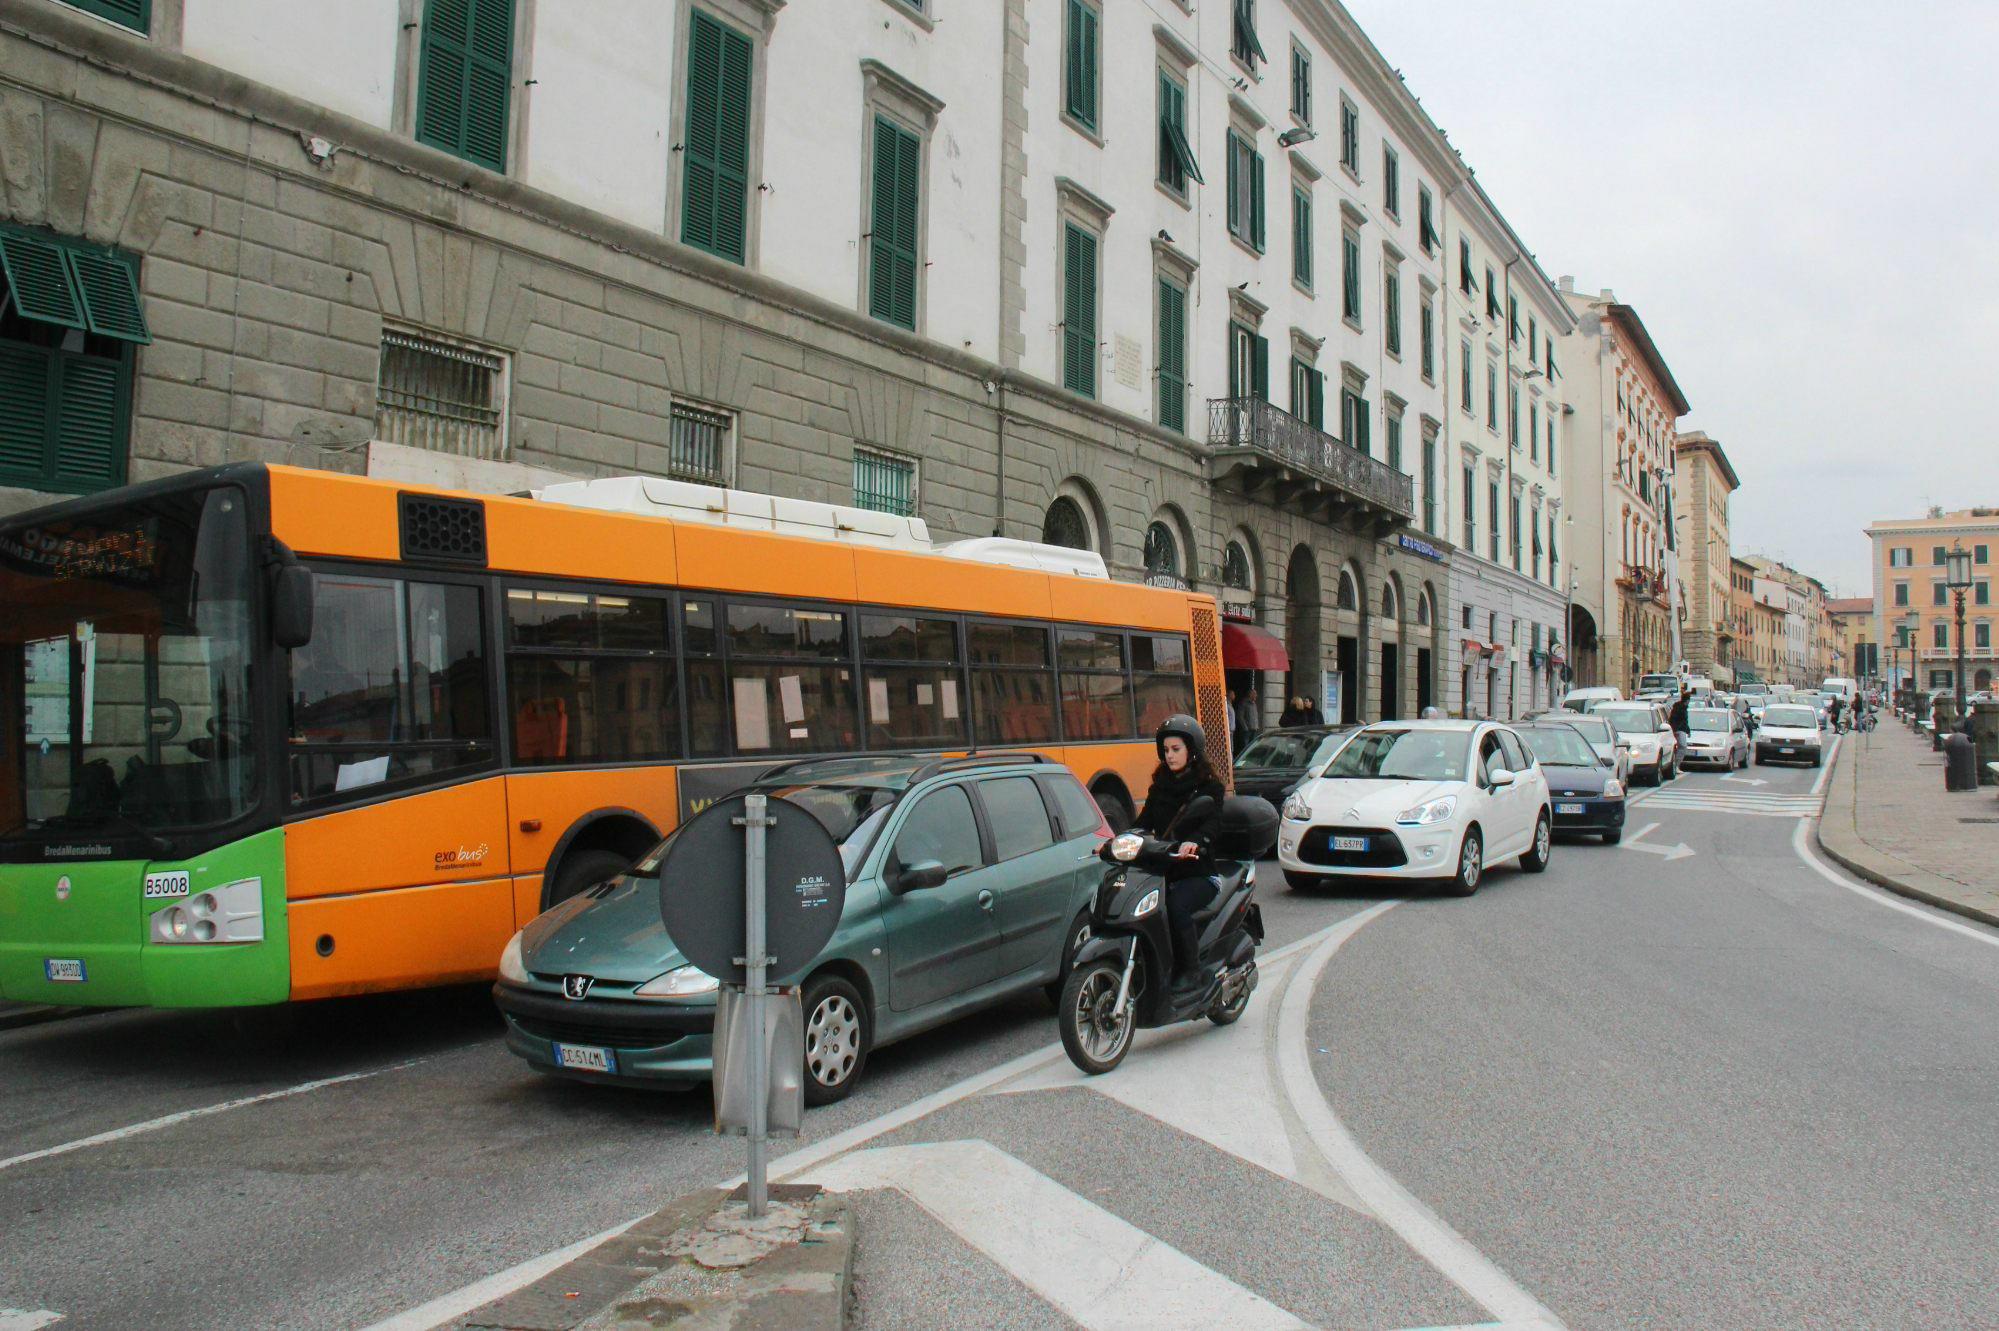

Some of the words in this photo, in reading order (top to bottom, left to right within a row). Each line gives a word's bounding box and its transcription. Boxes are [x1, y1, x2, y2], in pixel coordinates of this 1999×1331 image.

[44, 844, 112, 857] BredaMenarinibus
[435, 851, 456, 862] exo
[457, 845, 483, 861] bus
[146, 877, 188, 895] B5008
[801, 876, 825, 884] D.G.M.
